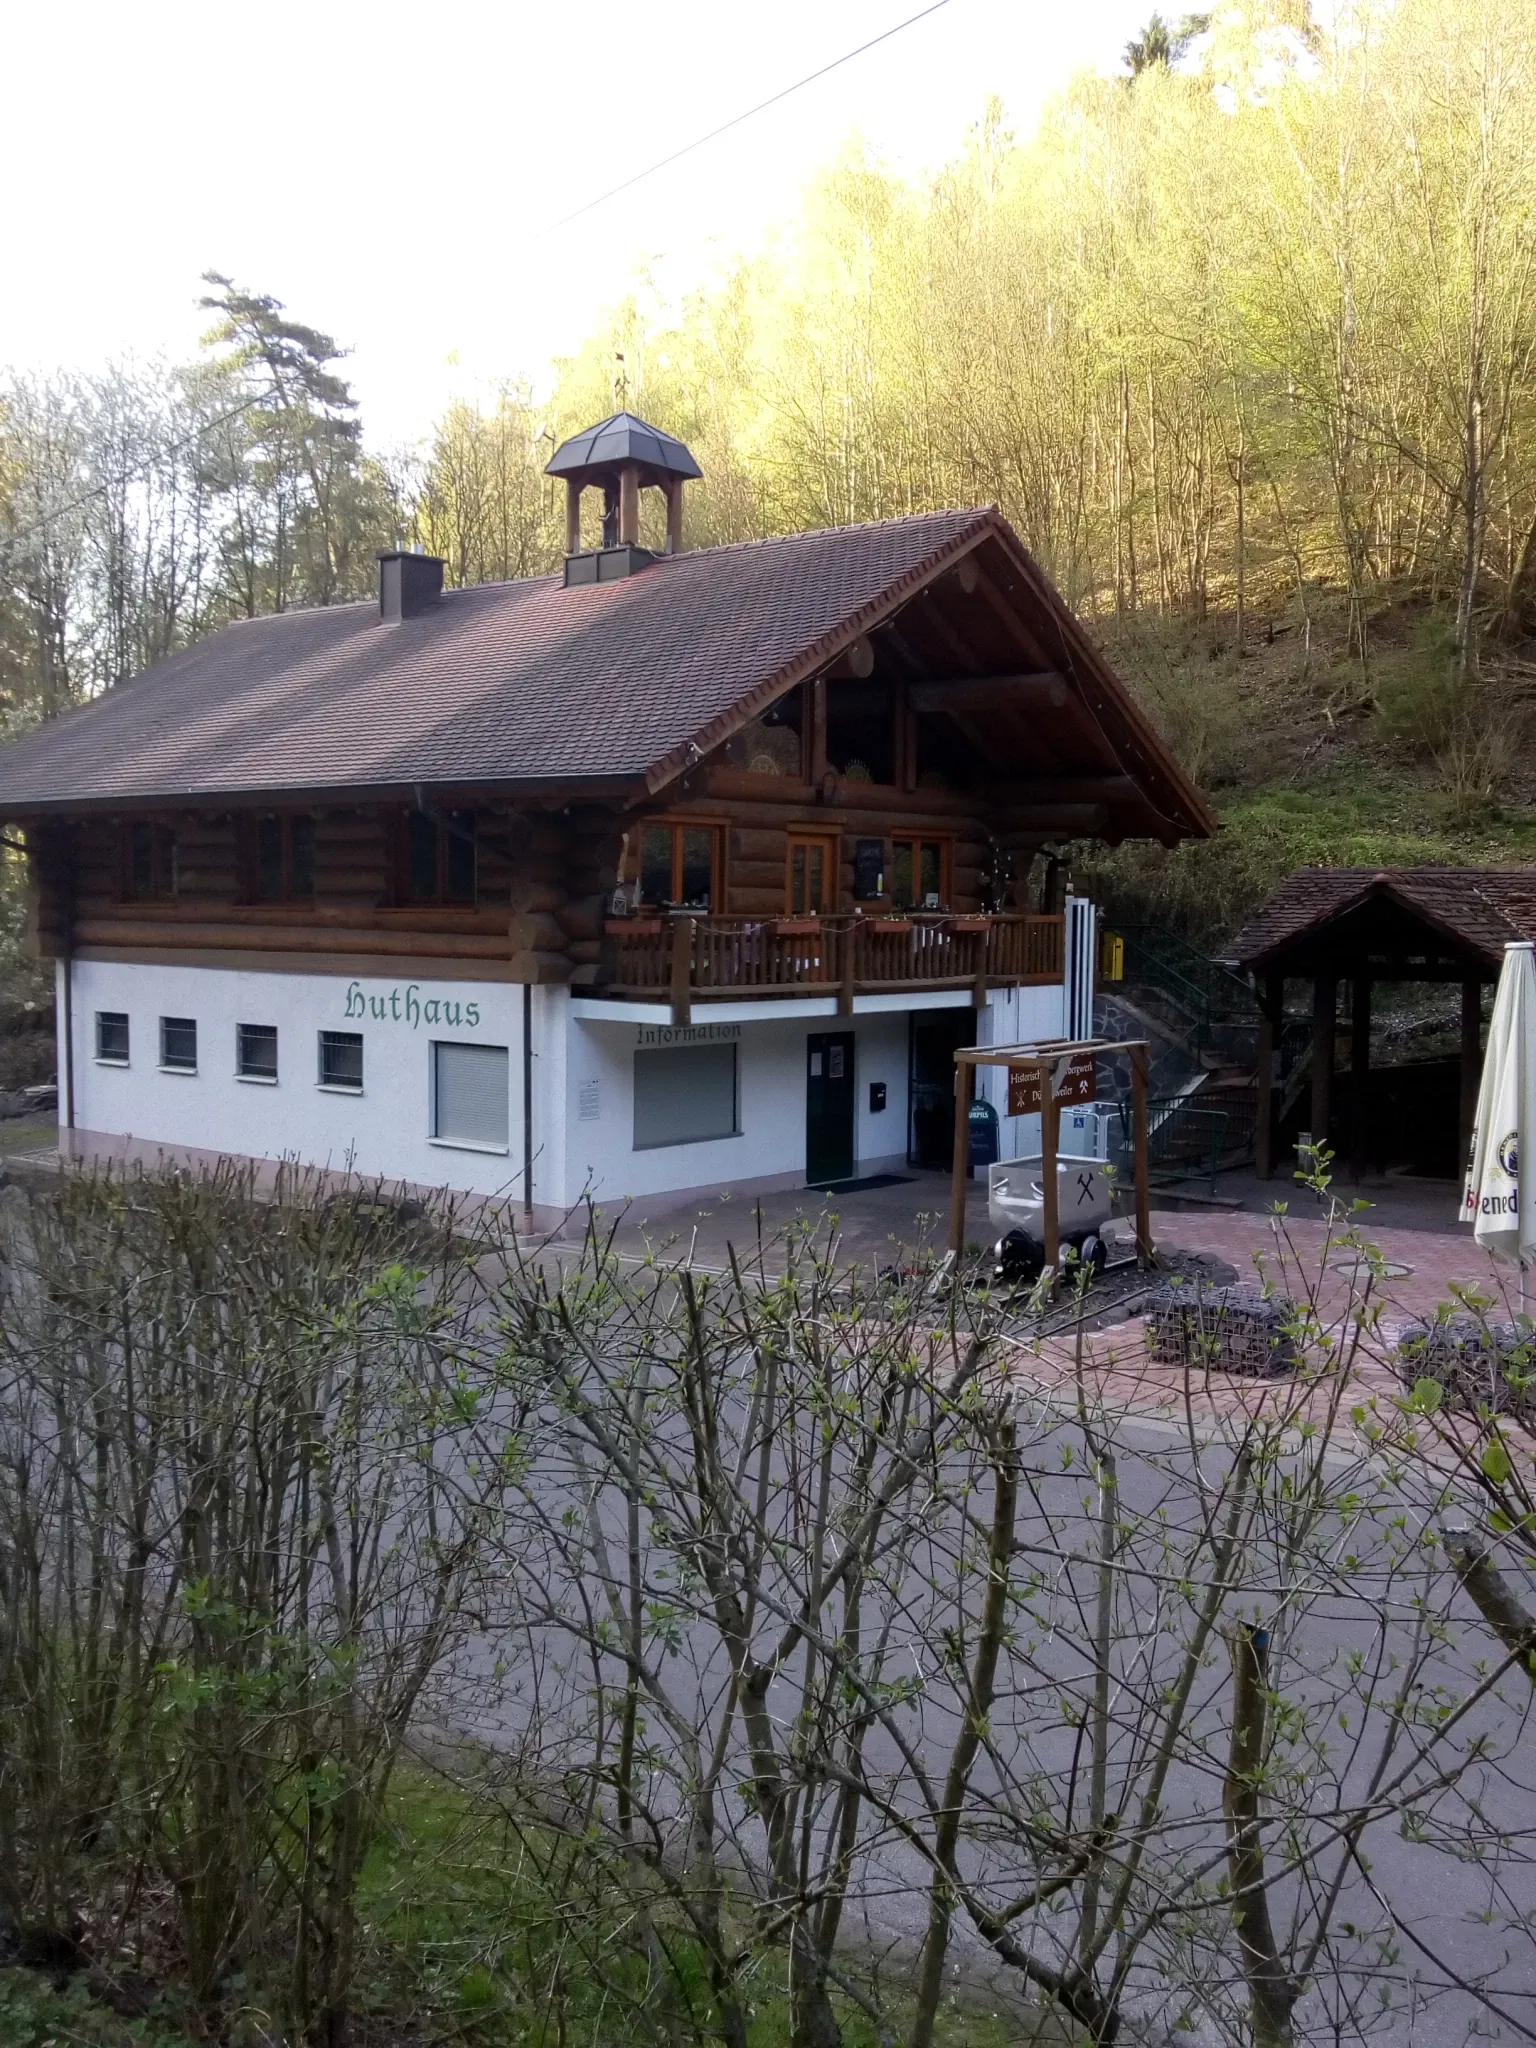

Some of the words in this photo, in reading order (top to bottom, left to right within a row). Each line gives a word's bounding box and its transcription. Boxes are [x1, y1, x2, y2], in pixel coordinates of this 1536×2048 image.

[344, 981, 480, 1029] Huthaus
[637, 1023, 742, 1046] Information
[1011, 1069, 1042, 1086] Historisch
